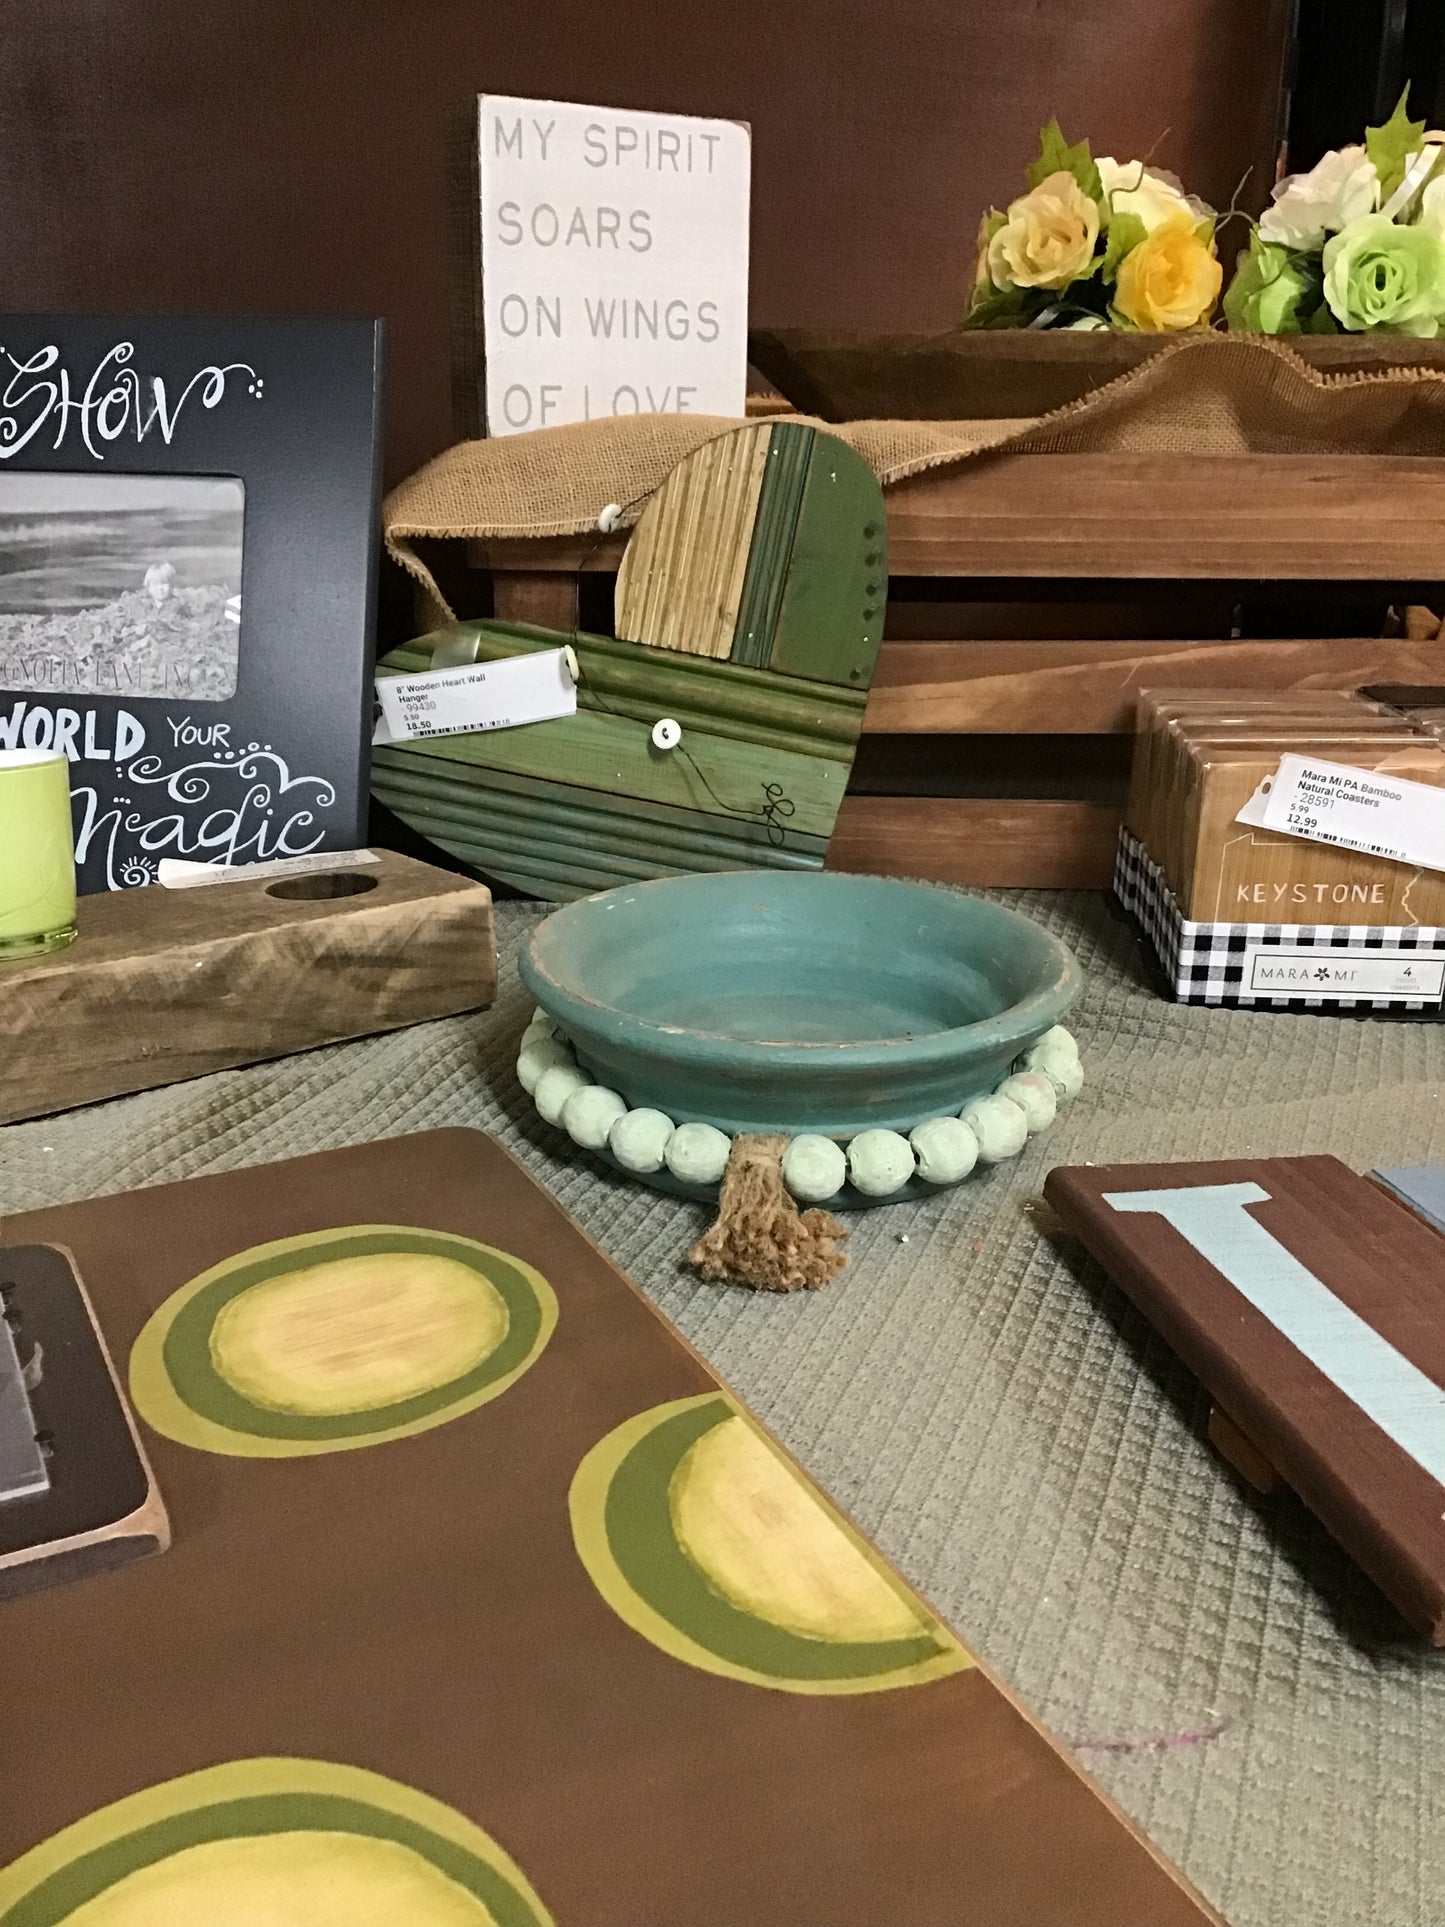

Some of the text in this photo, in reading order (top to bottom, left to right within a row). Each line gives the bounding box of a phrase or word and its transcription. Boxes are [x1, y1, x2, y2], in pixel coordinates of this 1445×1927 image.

[494, 115, 721, 174] MY SPIRIT
[498, 201, 653, 253] SOARS
[499, 293, 720, 343] ON WINGS
[502, 383, 562, 428] OF
[406, 681, 441, 693] Wooden
[442, 677, 466, 688] Heart
[467, 673, 486, 684] Wall
[398, 693, 429, 704] Hanger
[406, 701, 437, 712] 99430
[166, 716, 231, 747] YOUR
[406, 720, 432, 731] 18.50
[1297, 780, 1380, 808] Natural Coasters
[1301, 769, 1402, 801] Mara Mi PA Bamboo
[1290, 803, 1310, 814] 5.99
[1299, 792, 1335, 809] 28591
[1286, 813, 1318, 828] 12.99
[1236, 882, 1385, 904] KEYSTONE
[1260, 967, 1356, 981] MARA MI
[1403, 966, 1412, 977] 4
